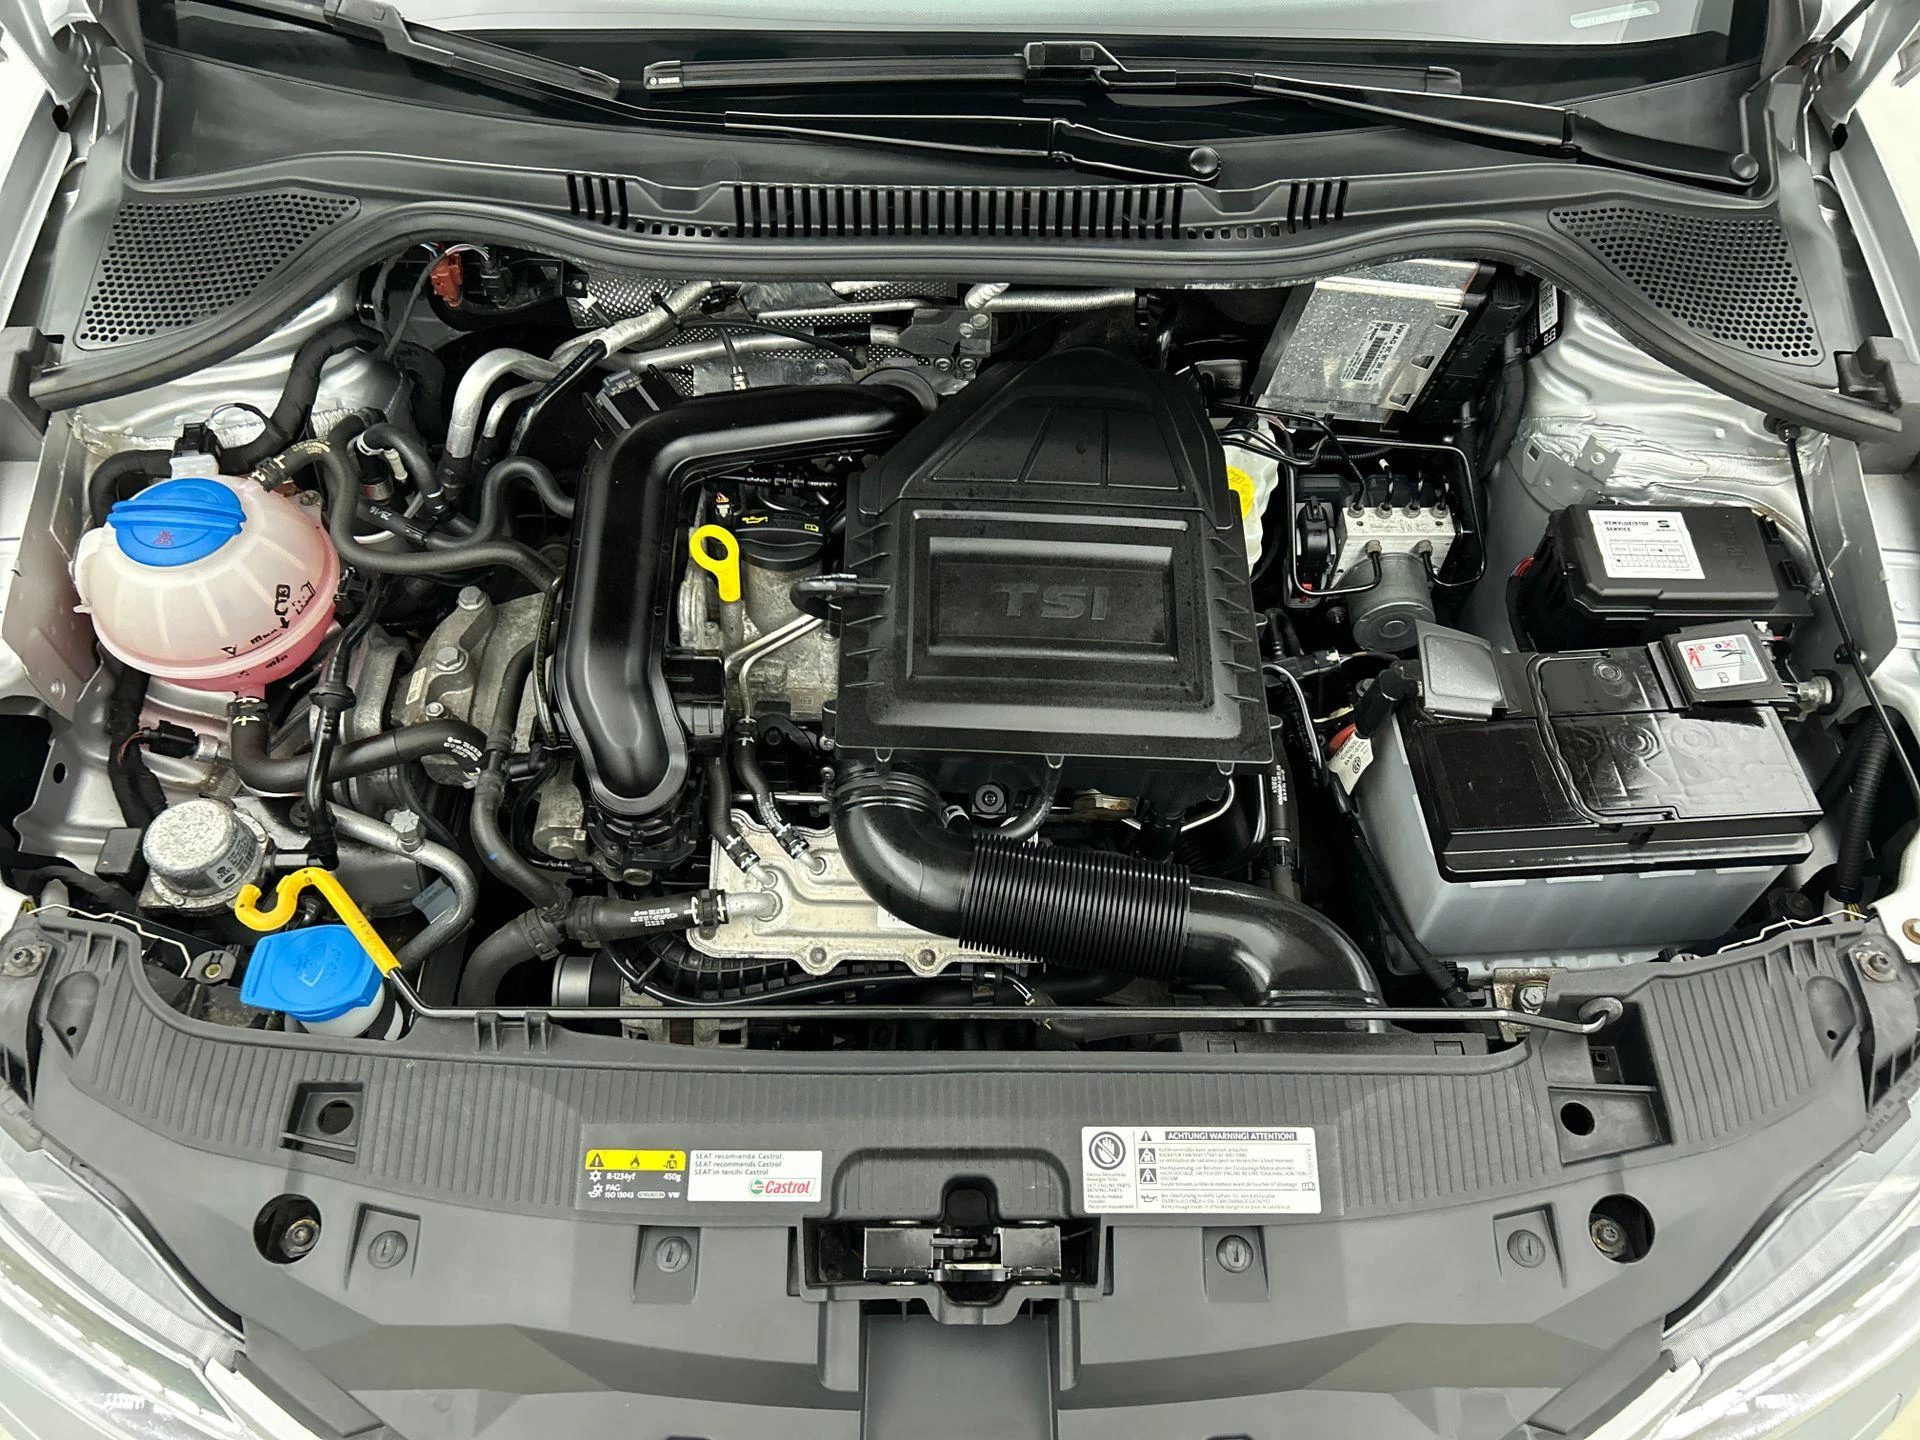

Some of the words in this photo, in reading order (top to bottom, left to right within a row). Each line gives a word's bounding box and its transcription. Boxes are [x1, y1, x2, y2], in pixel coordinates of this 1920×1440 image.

[993, 582, 1109, 621] TSI
[1167, 1131, 1209, 1140] ACHTUNG!
[1209, 1131, 1250, 1140] WARNING!
[1250, 1131, 1296, 1140] ATTENTION!
[695, 1152, 713, 1160] SEAT
[714, 1152, 756, 1160] recomienda
[695, 1160, 712, 1168] SEAT
[713, 1160, 756, 1168] recommends
[758, 1160, 782, 1168] Castrol
[741, 1168, 769, 1176] Castrol
[606, 1172, 636, 1182] R-1234yf
[663, 1172, 682, 1182] 450g
[765, 1179, 810, 1194] Castrol
